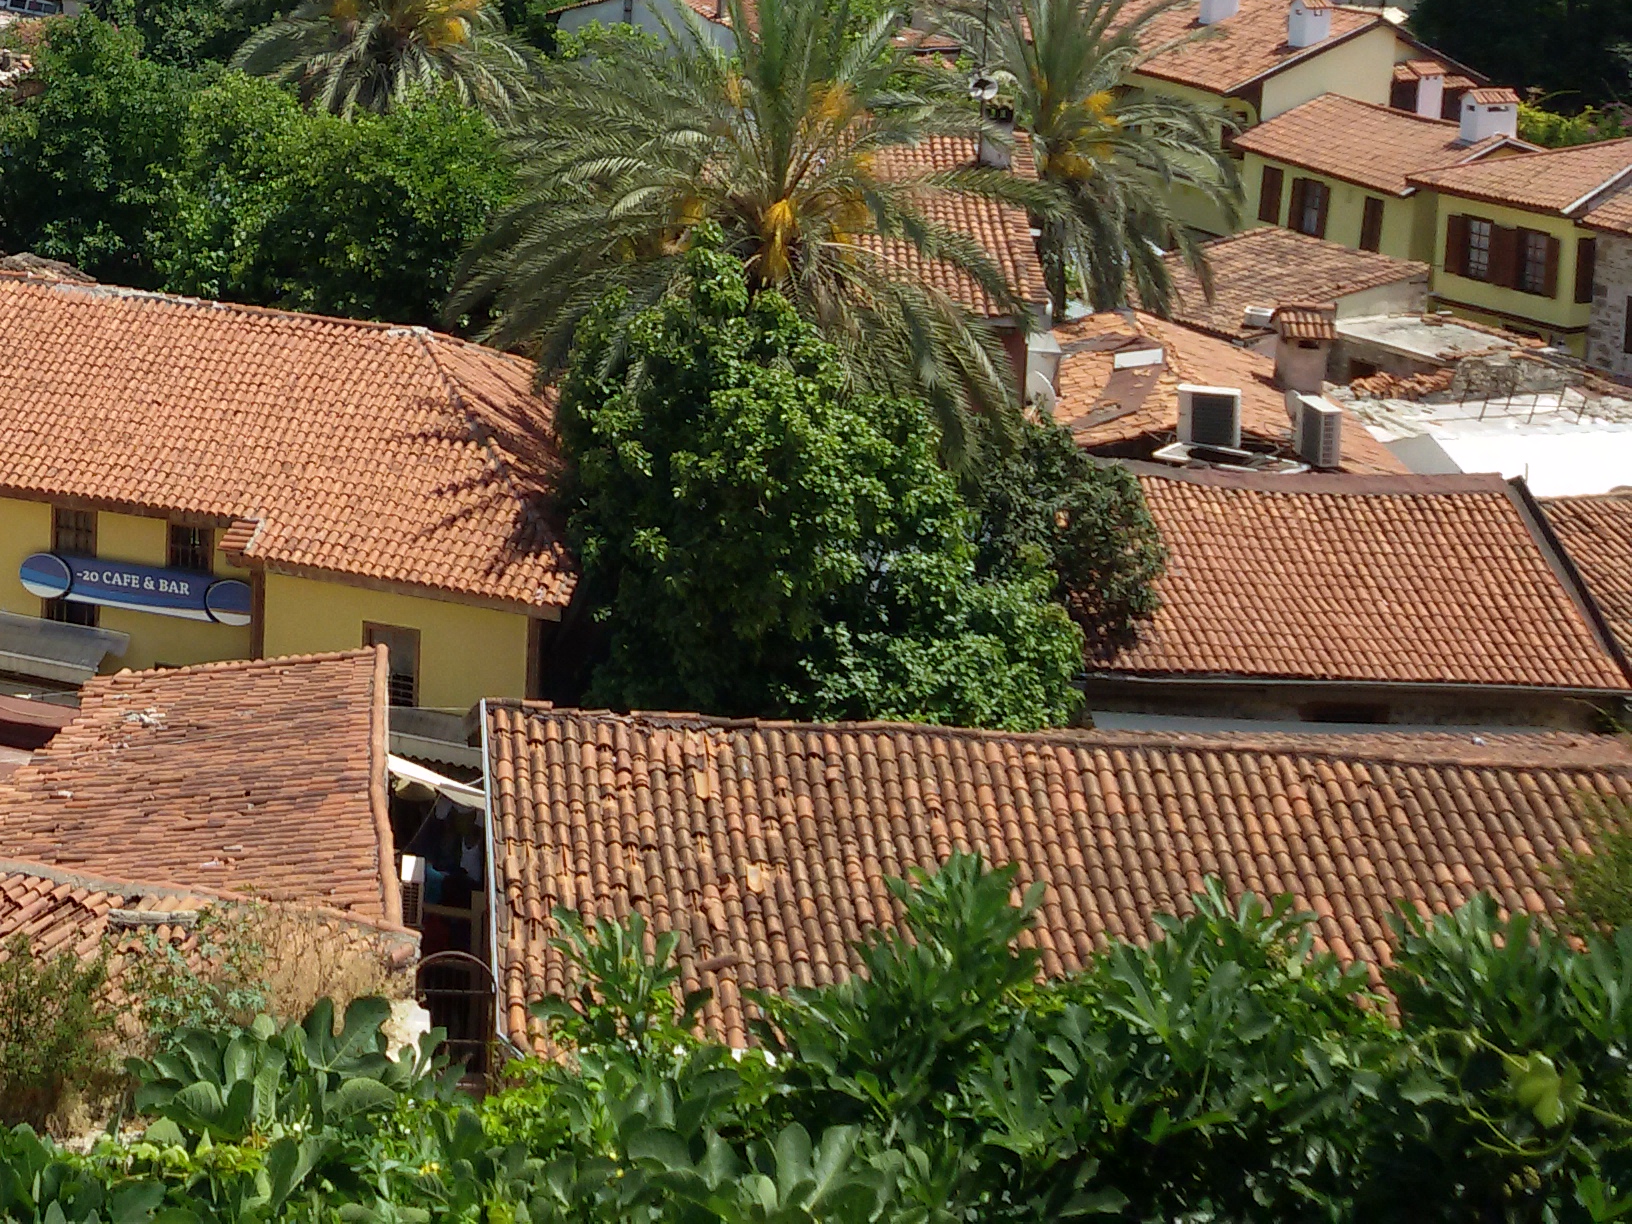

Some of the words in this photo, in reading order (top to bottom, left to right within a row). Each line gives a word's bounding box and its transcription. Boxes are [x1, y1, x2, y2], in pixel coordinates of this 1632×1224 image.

[102, 571, 139, 588] CAFE
[143, 576, 155, 590] &
[159, 578, 190, 596] BAR
